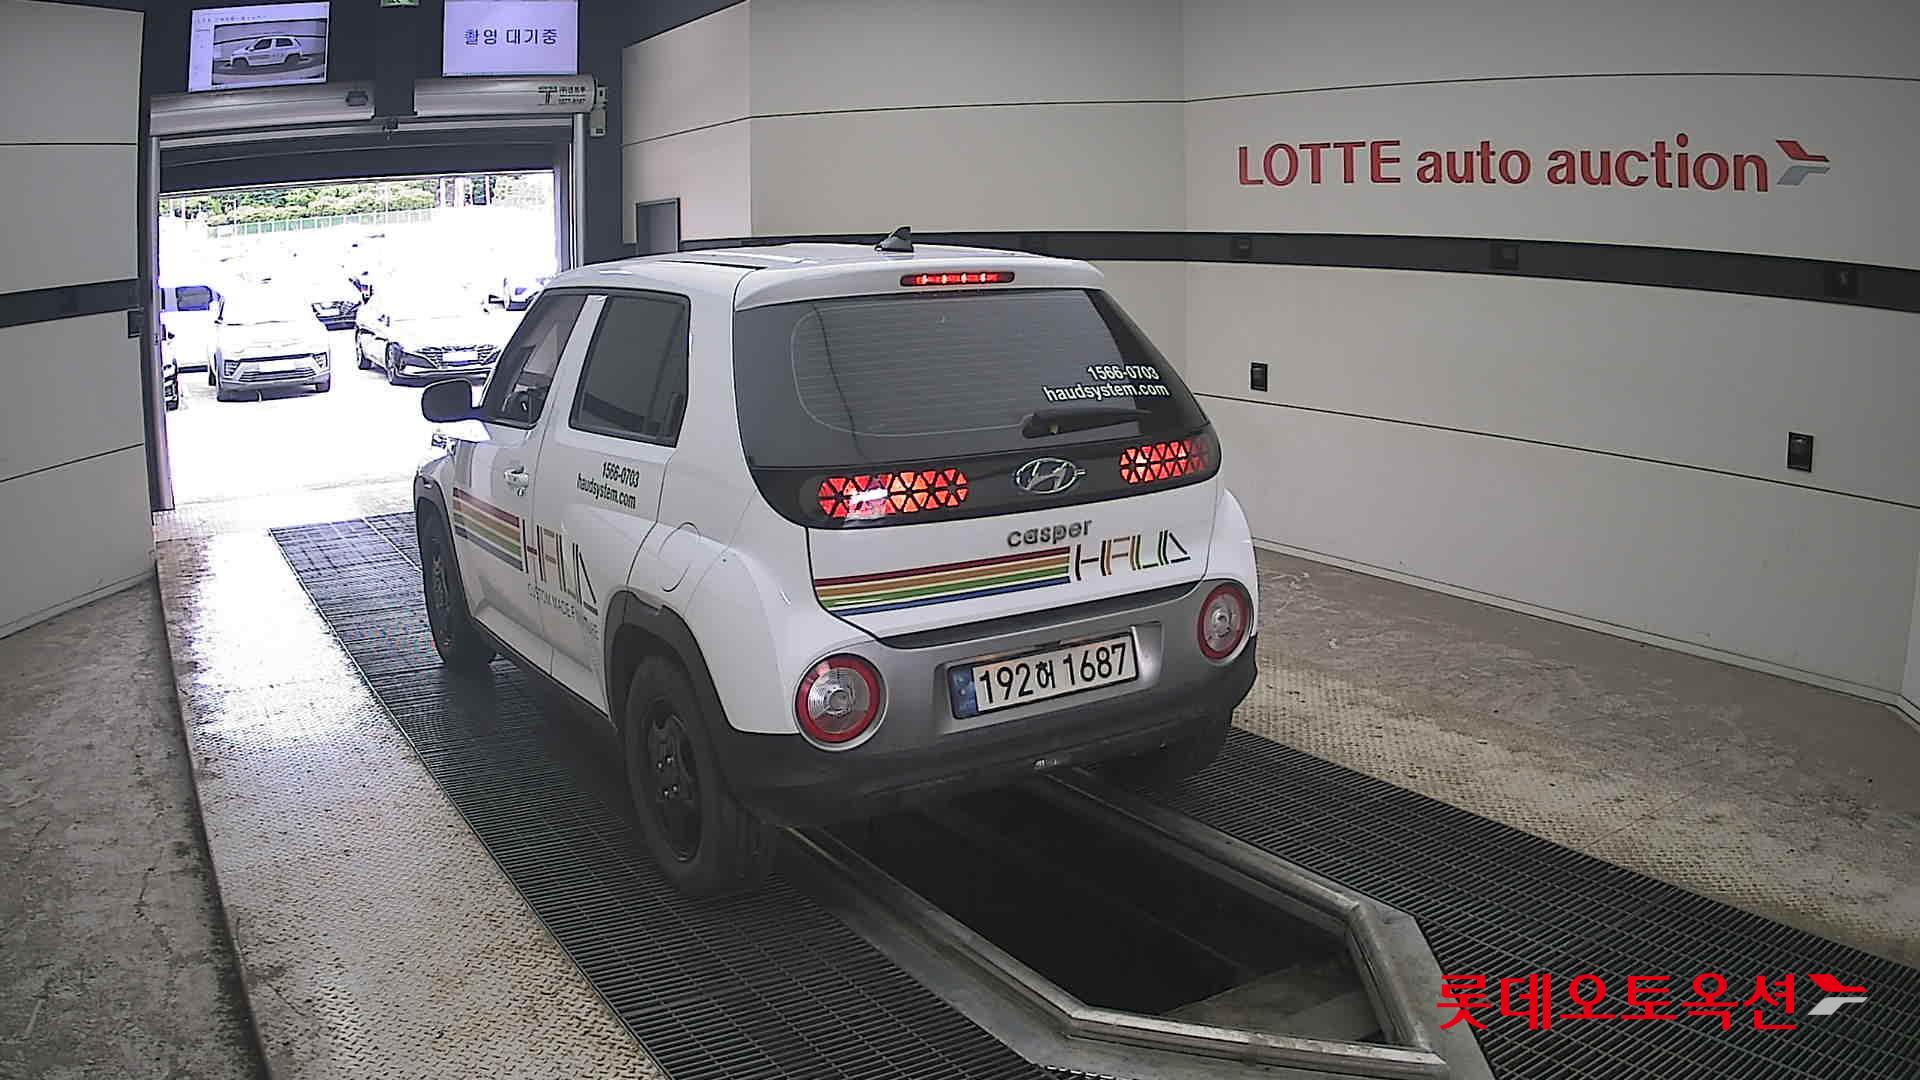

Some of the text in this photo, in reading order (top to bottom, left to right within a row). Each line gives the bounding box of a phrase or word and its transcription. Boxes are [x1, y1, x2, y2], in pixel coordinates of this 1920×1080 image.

[506, 28, 558, 45] 대기중
[1238, 132, 1769, 193] LOTTE auto auction
[1087, 364, 1160, 381] 1566-0703
[1043, 382, 1170, 402] haudsystem.com
[601, 461, 640, 488] 1566-0703
[577, 471, 636, 510] haudsystem.com
[1007, 518, 1093, 551] casper
[979, 642, 1127, 704] 192허 1687
